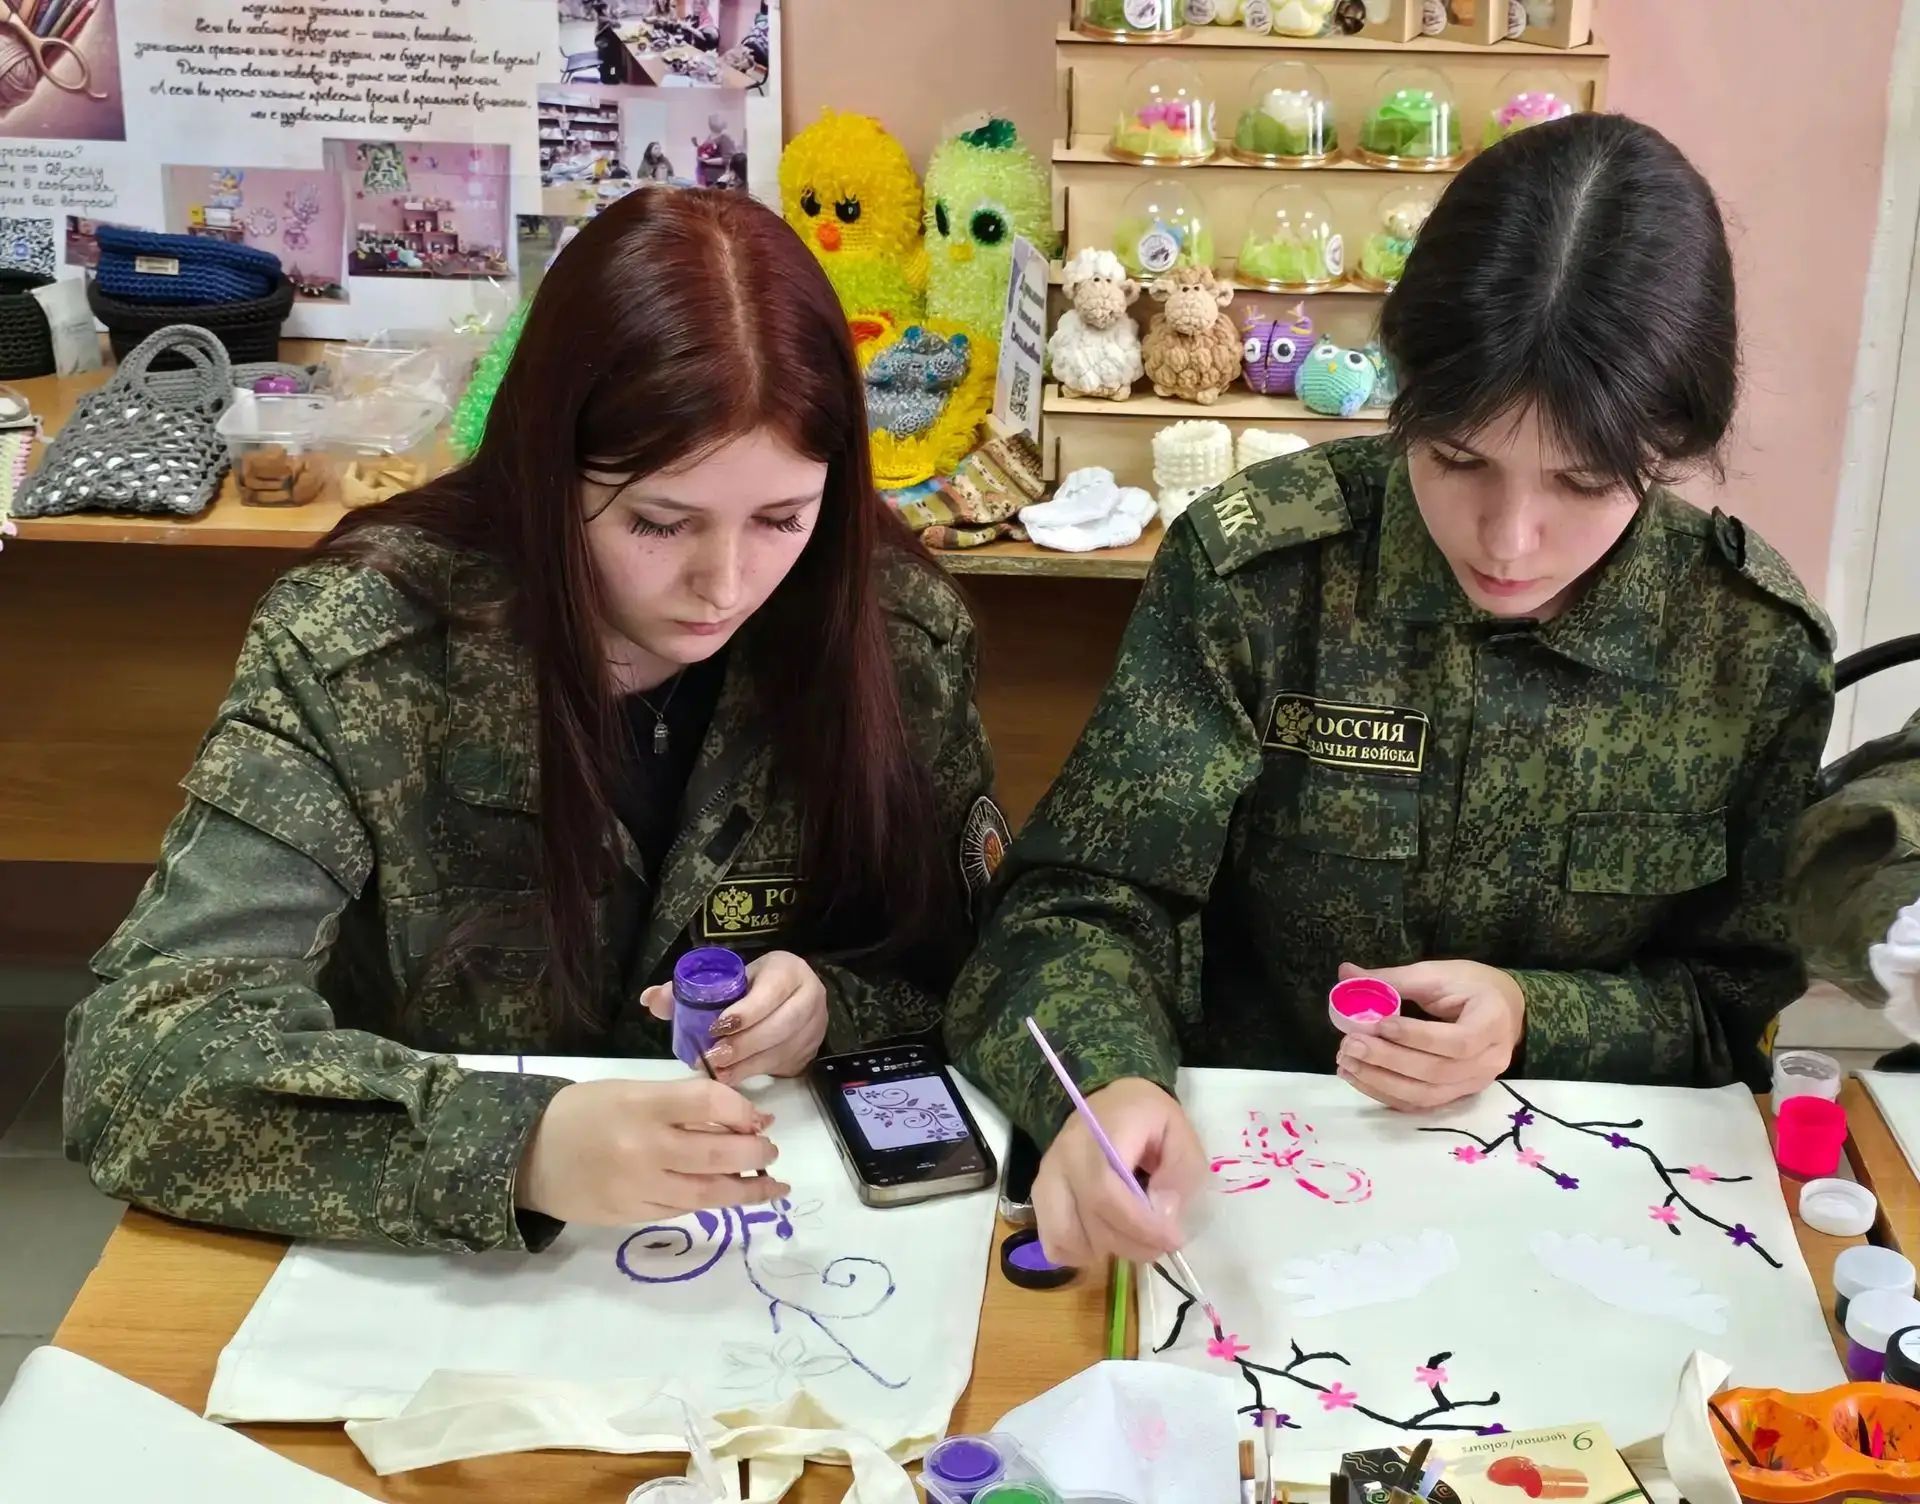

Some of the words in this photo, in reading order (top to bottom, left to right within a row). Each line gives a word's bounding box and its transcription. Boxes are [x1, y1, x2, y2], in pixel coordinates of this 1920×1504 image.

[1316, 716, 1406, 743] ОССИЯ
[1307, 738, 1357, 758] ЗАЧЬИ
[1360, 745, 1415, 764] ВОЙСКА
[1573, 1430, 1593, 1450] 9
